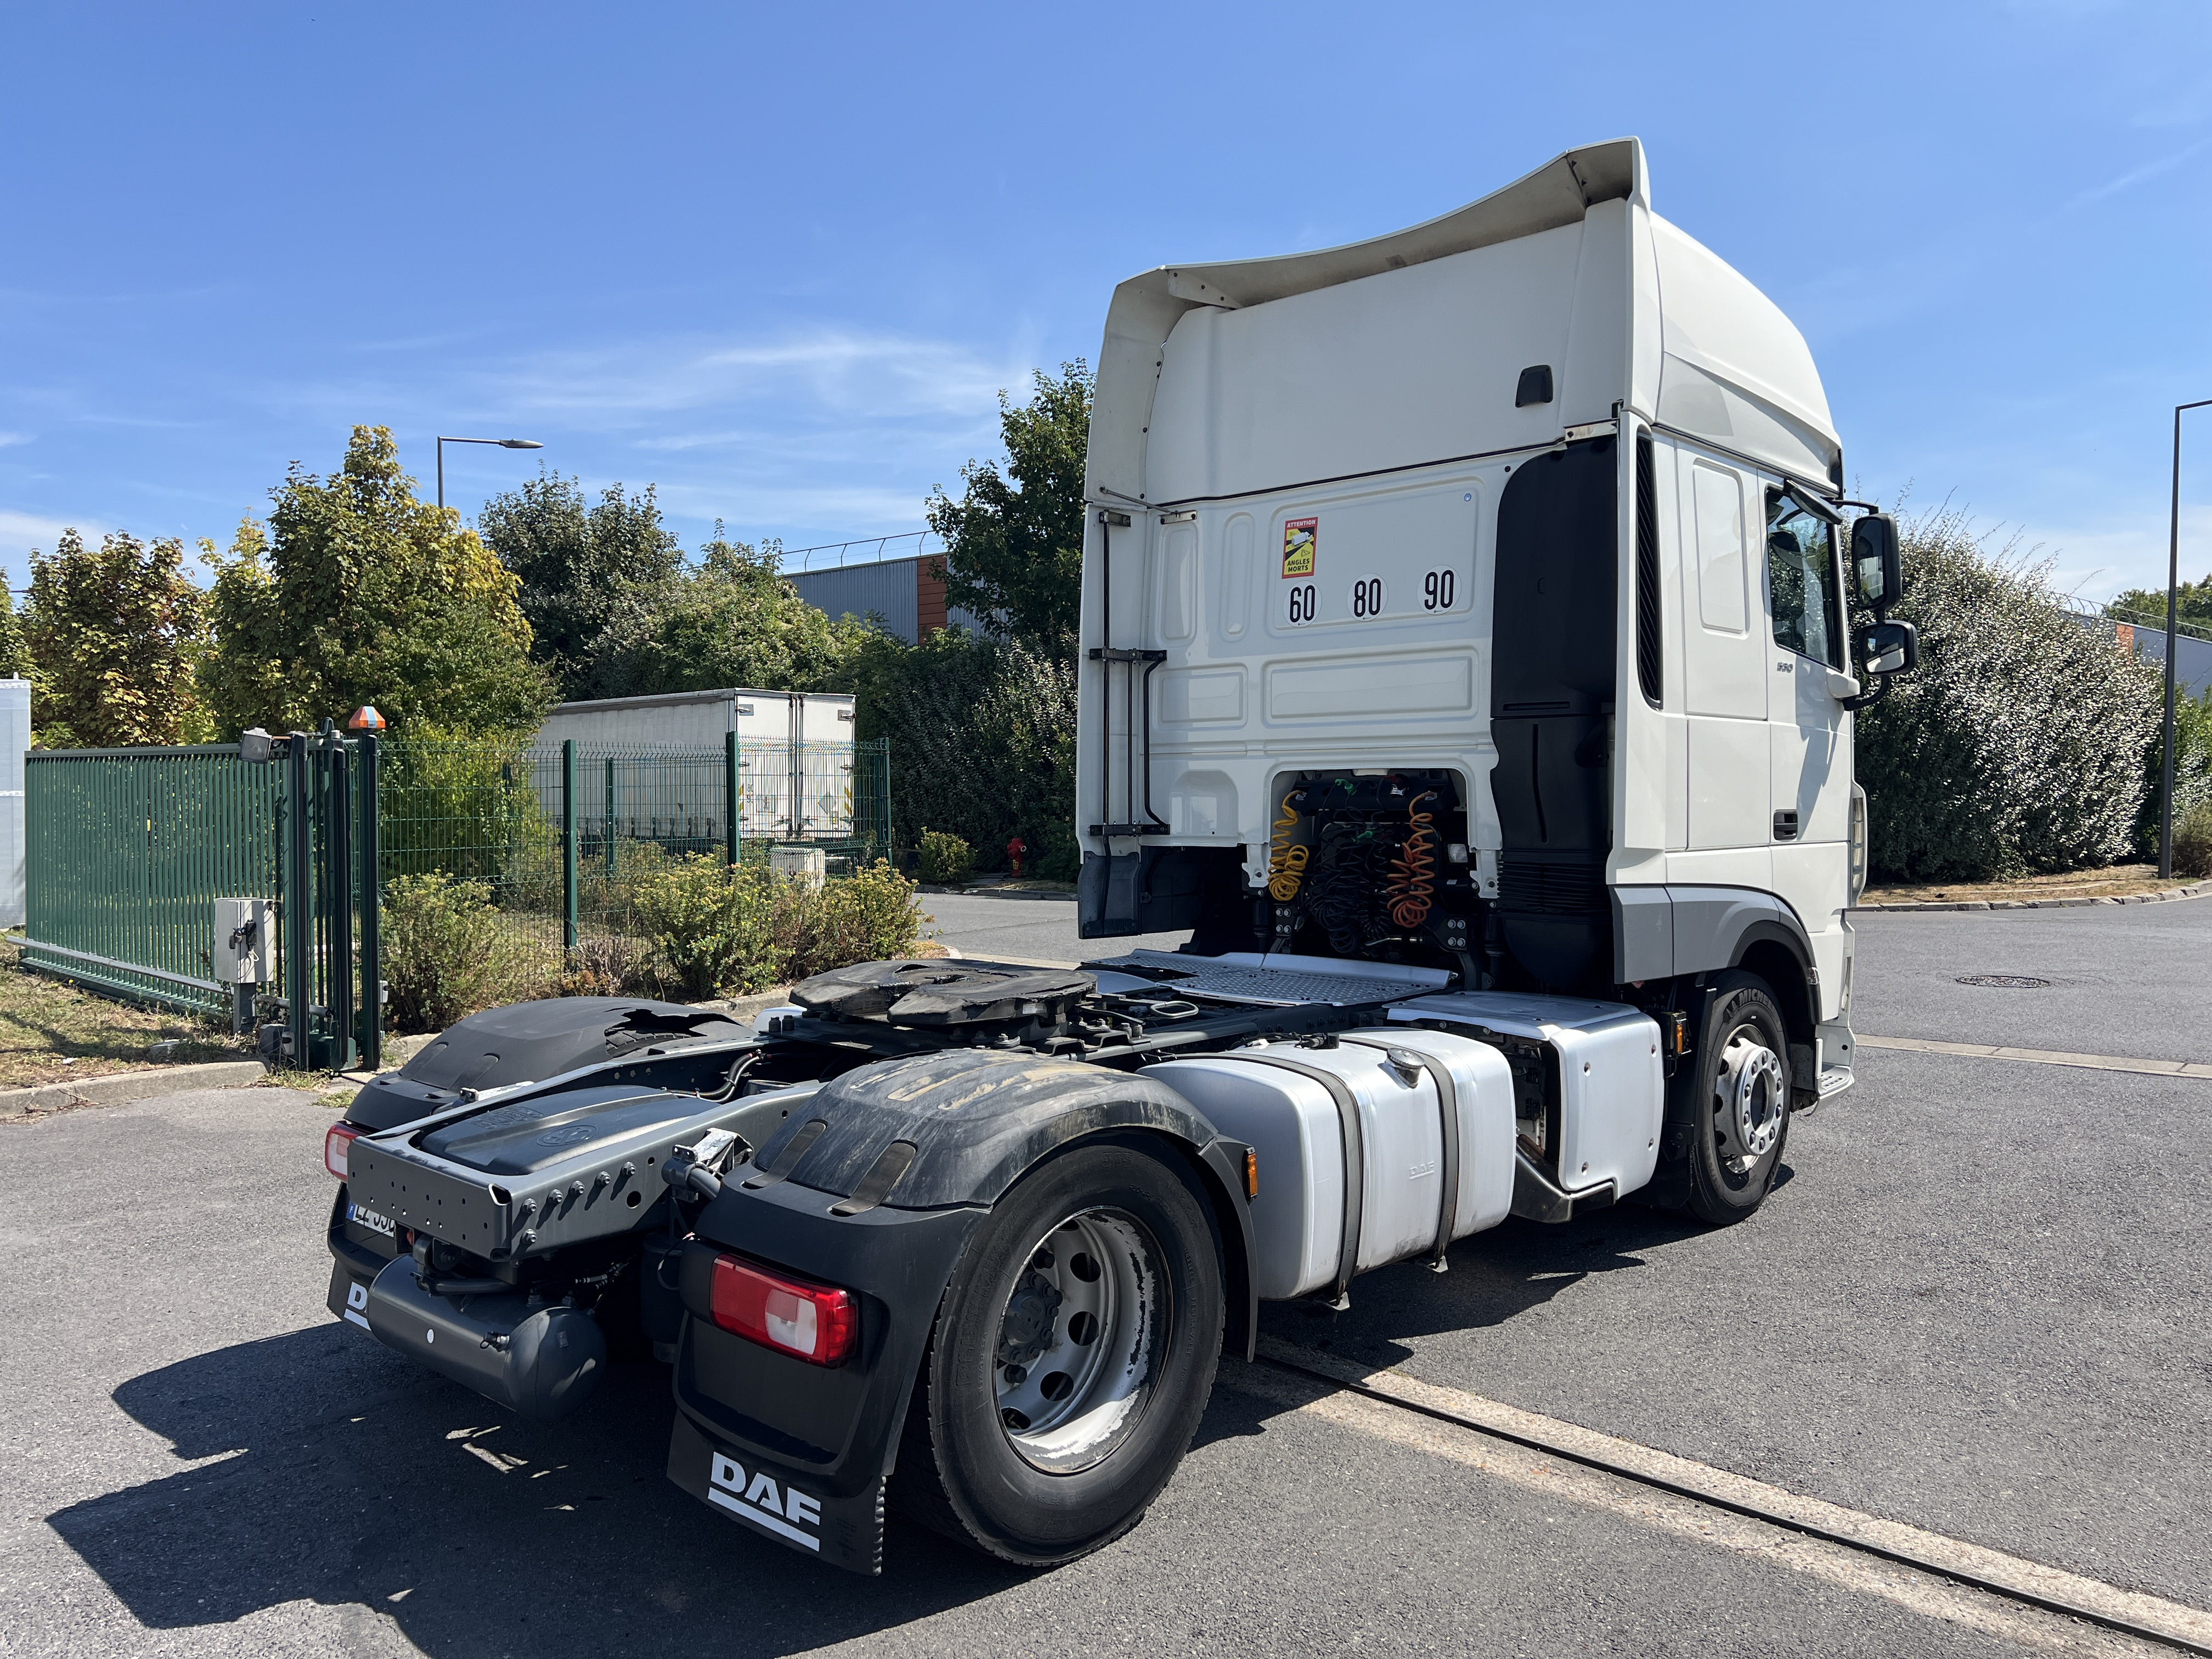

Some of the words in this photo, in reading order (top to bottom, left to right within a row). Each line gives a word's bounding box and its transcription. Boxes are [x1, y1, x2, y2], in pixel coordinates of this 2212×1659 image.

[1287, 520, 1316, 528] ATTENTION
[1289, 584, 1316, 623] 60
[1353, 578, 1381, 617] 80
[1424, 569, 1454, 610] 90
[1409, 1161, 1434, 1176] DAF
[710, 1451, 821, 1526] DAF
